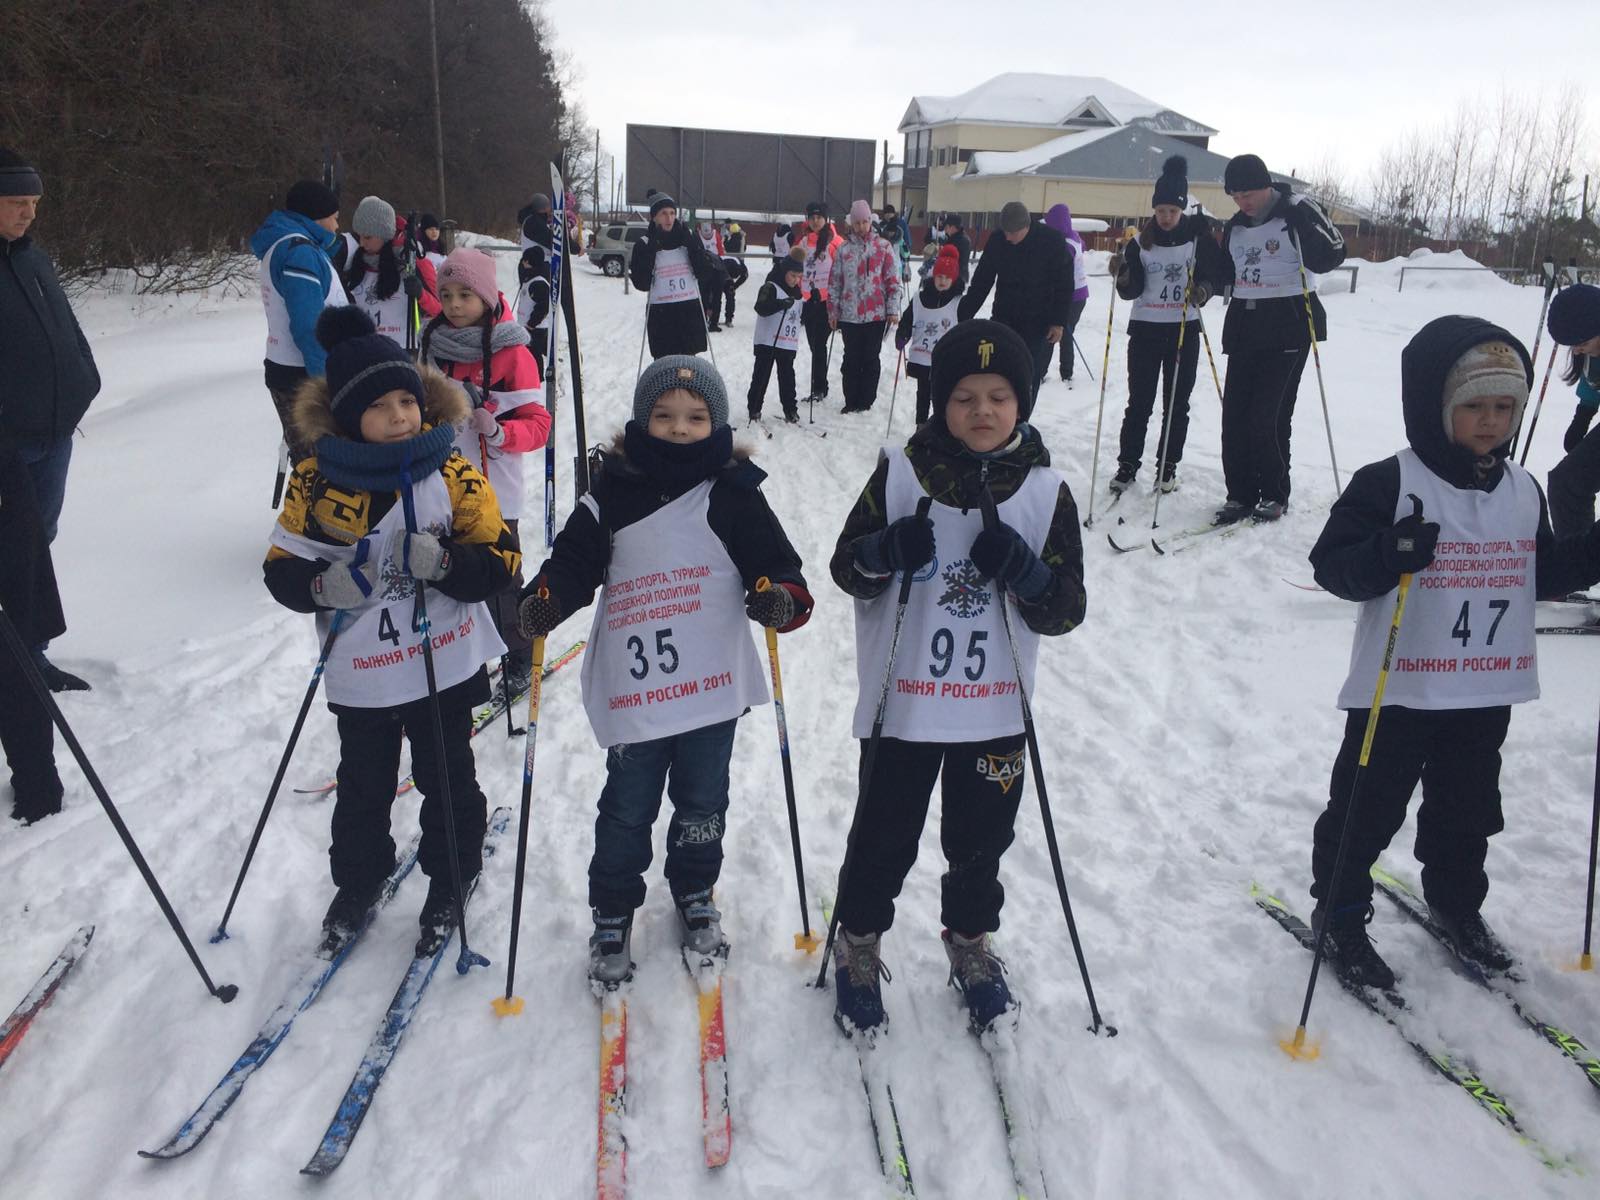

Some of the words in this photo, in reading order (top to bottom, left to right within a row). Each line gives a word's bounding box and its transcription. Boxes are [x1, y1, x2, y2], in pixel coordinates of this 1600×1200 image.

[552, 209, 562, 256] TISA
[669, 278, 686, 291] 50
[1241, 267, 1260, 284] 45
[1160, 285, 1181, 302] 46
[785, 325, 796, 337] 96
[1434, 542, 1480, 555] ТЕРСТВО
[636, 572, 672, 591] СПОРТА,
[671, 565, 713, 582] ТУРИЗМА
[1420, 574, 1486, 589] РОССИЙСКОЙ
[654, 582, 702, 604] ПОЛИТИКИ
[648, 599, 702, 620] ФЕДЕРАЦИИ
[944, 605, 987, 620] РОССИИ
[1451, 599, 1510, 648] 47
[352, 648, 405, 671] ЛЫЖНЯ
[407, 629, 456, 660] РОСИИ
[626, 627, 680, 681] 35
[929, 628, 989, 681] 95
[1394, 657, 1458, 673] ЛЫЖНЯ
[1462, 656, 1511, 673] РОССИИ
[608, 693, 643, 711] ЫЖНЯ
[646, 680, 699, 705] РОССИИ
[703, 671, 732, 692] 2011
[992, 681, 1017, 696] 2011
